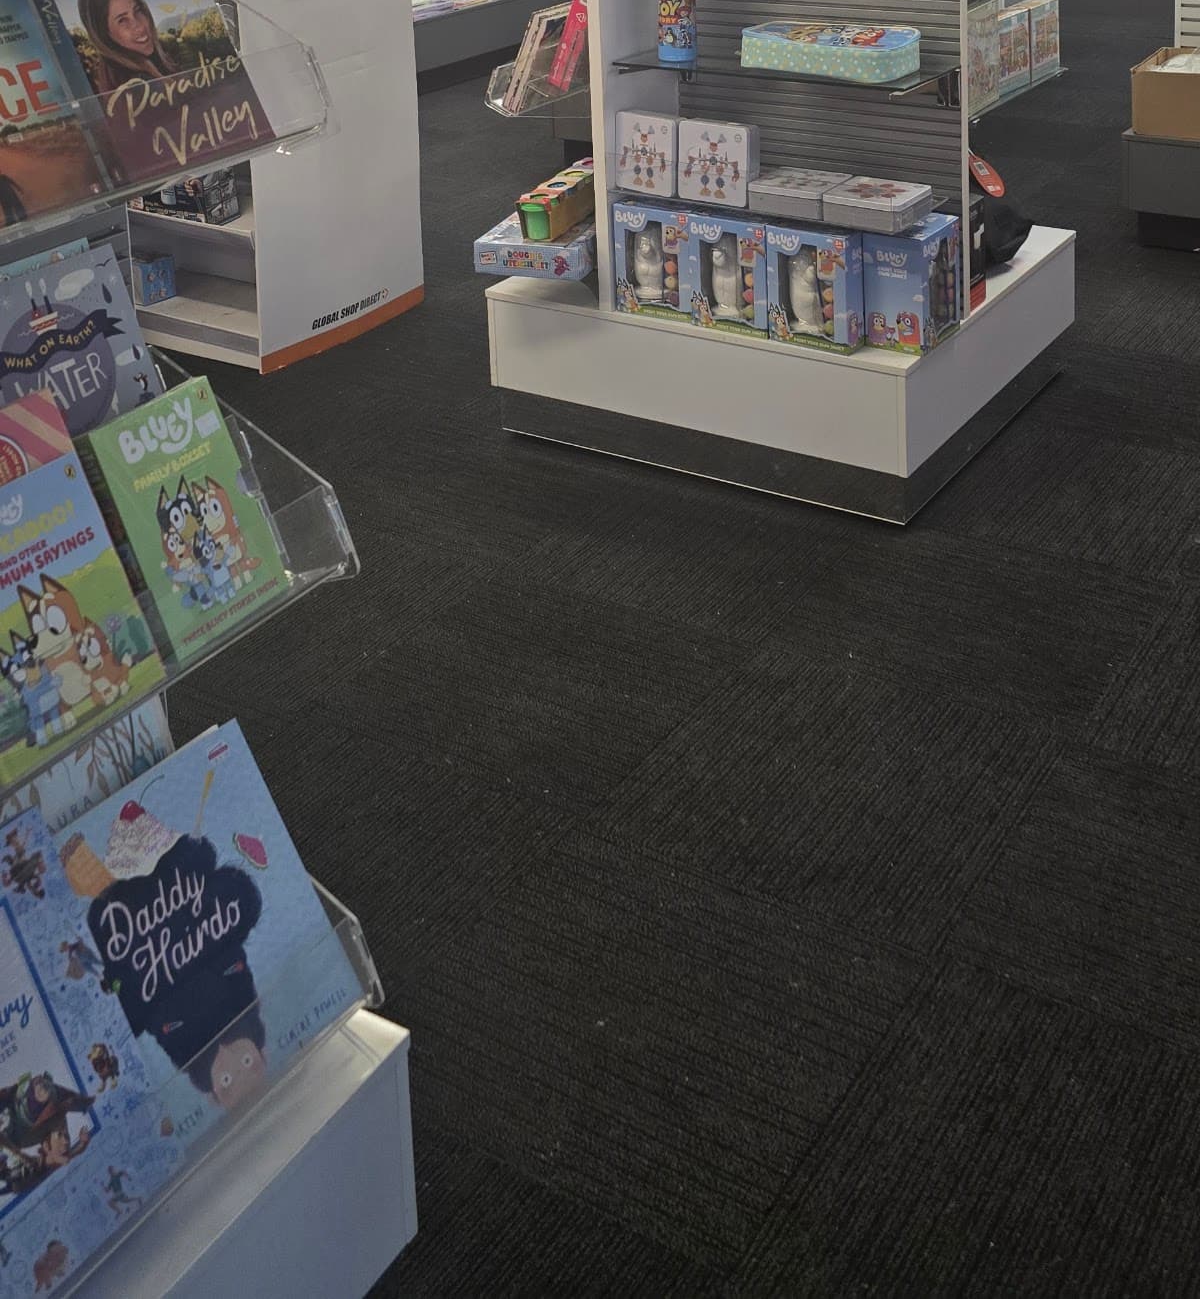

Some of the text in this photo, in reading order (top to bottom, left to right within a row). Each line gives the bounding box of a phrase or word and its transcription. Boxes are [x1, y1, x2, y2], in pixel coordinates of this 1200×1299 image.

[0, 60, 61, 123] CE
[106, 51, 241, 130] Paradise
[153, 100, 258, 166] Valley
[615, 210, 645, 228] BLUEY
[690, 222, 721, 240] BLUEY
[767, 231, 799, 251] BLUEY
[876, 250, 908, 267] BLUEY
[312, 290, 381, 330] GLOBAL SHOP DIRECT
[5, 320, 95, 368] WHAT ON EARTH?
[118, 398, 194, 464] BLUEY
[0, 526, 95, 590] MUM SAYINGS
[19, 539, 47, 561] OTHER
[100, 867, 205, 962] Daddy
[131, 896, 241, 1002] Hairdo
